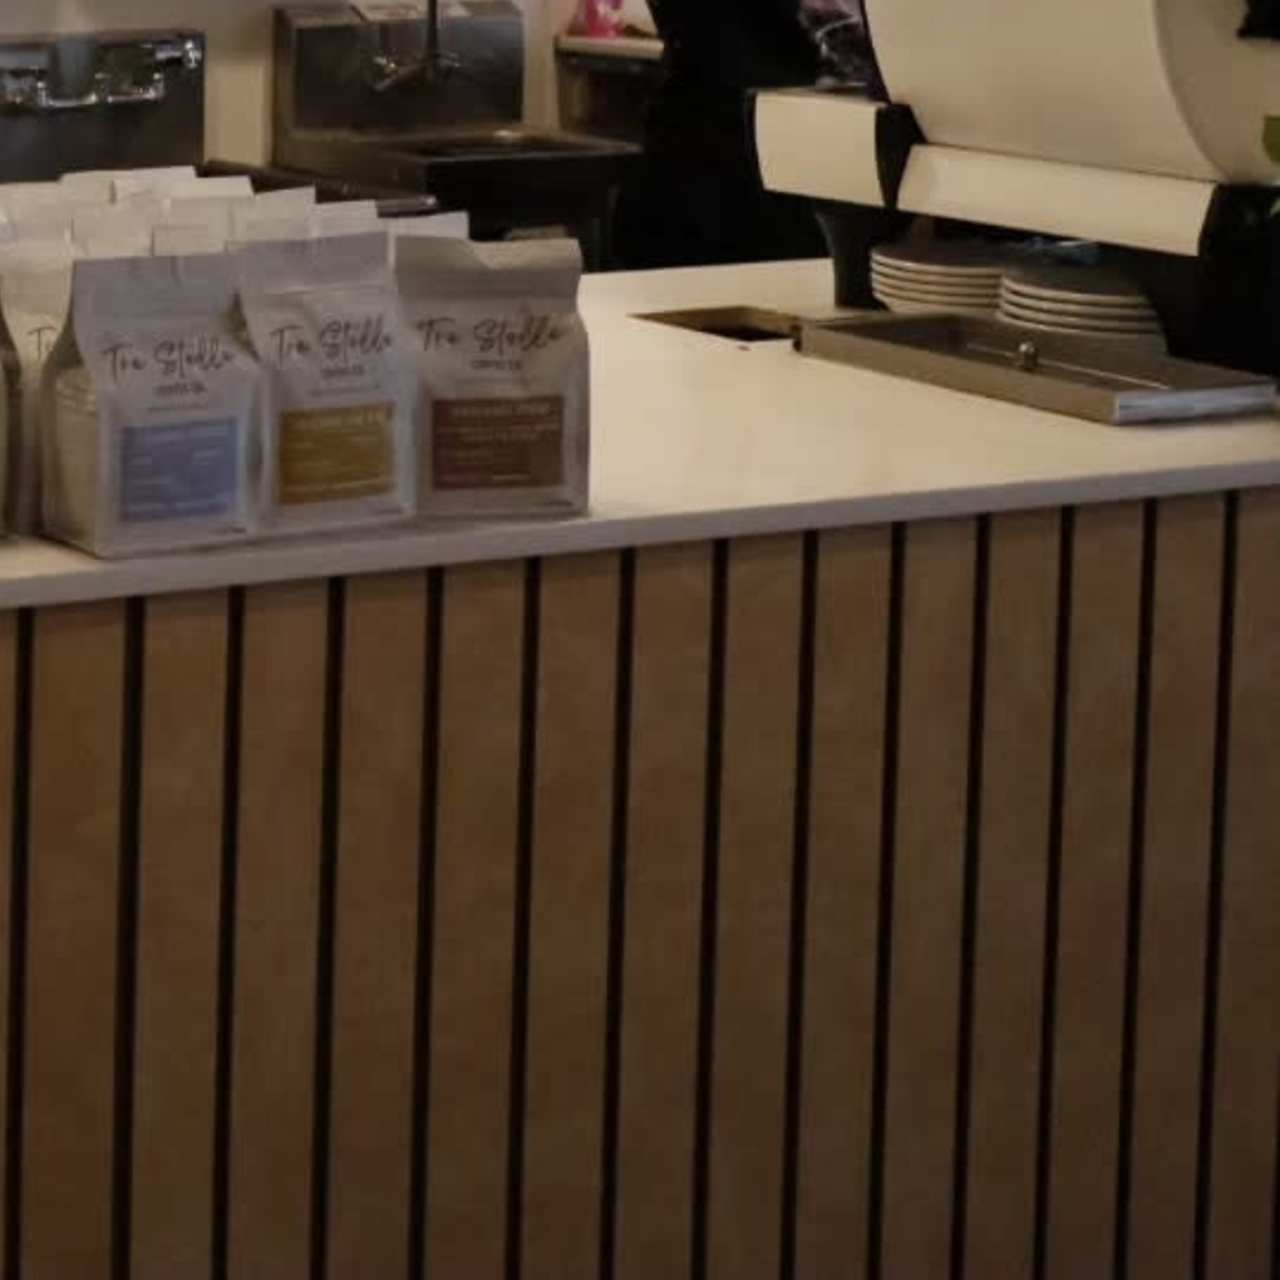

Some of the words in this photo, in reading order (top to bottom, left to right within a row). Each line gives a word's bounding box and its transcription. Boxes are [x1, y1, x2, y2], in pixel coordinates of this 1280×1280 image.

[268, 323, 312, 369] Tre
[415, 316, 460, 353] Tre
[100, 342, 148, 385] Tre
